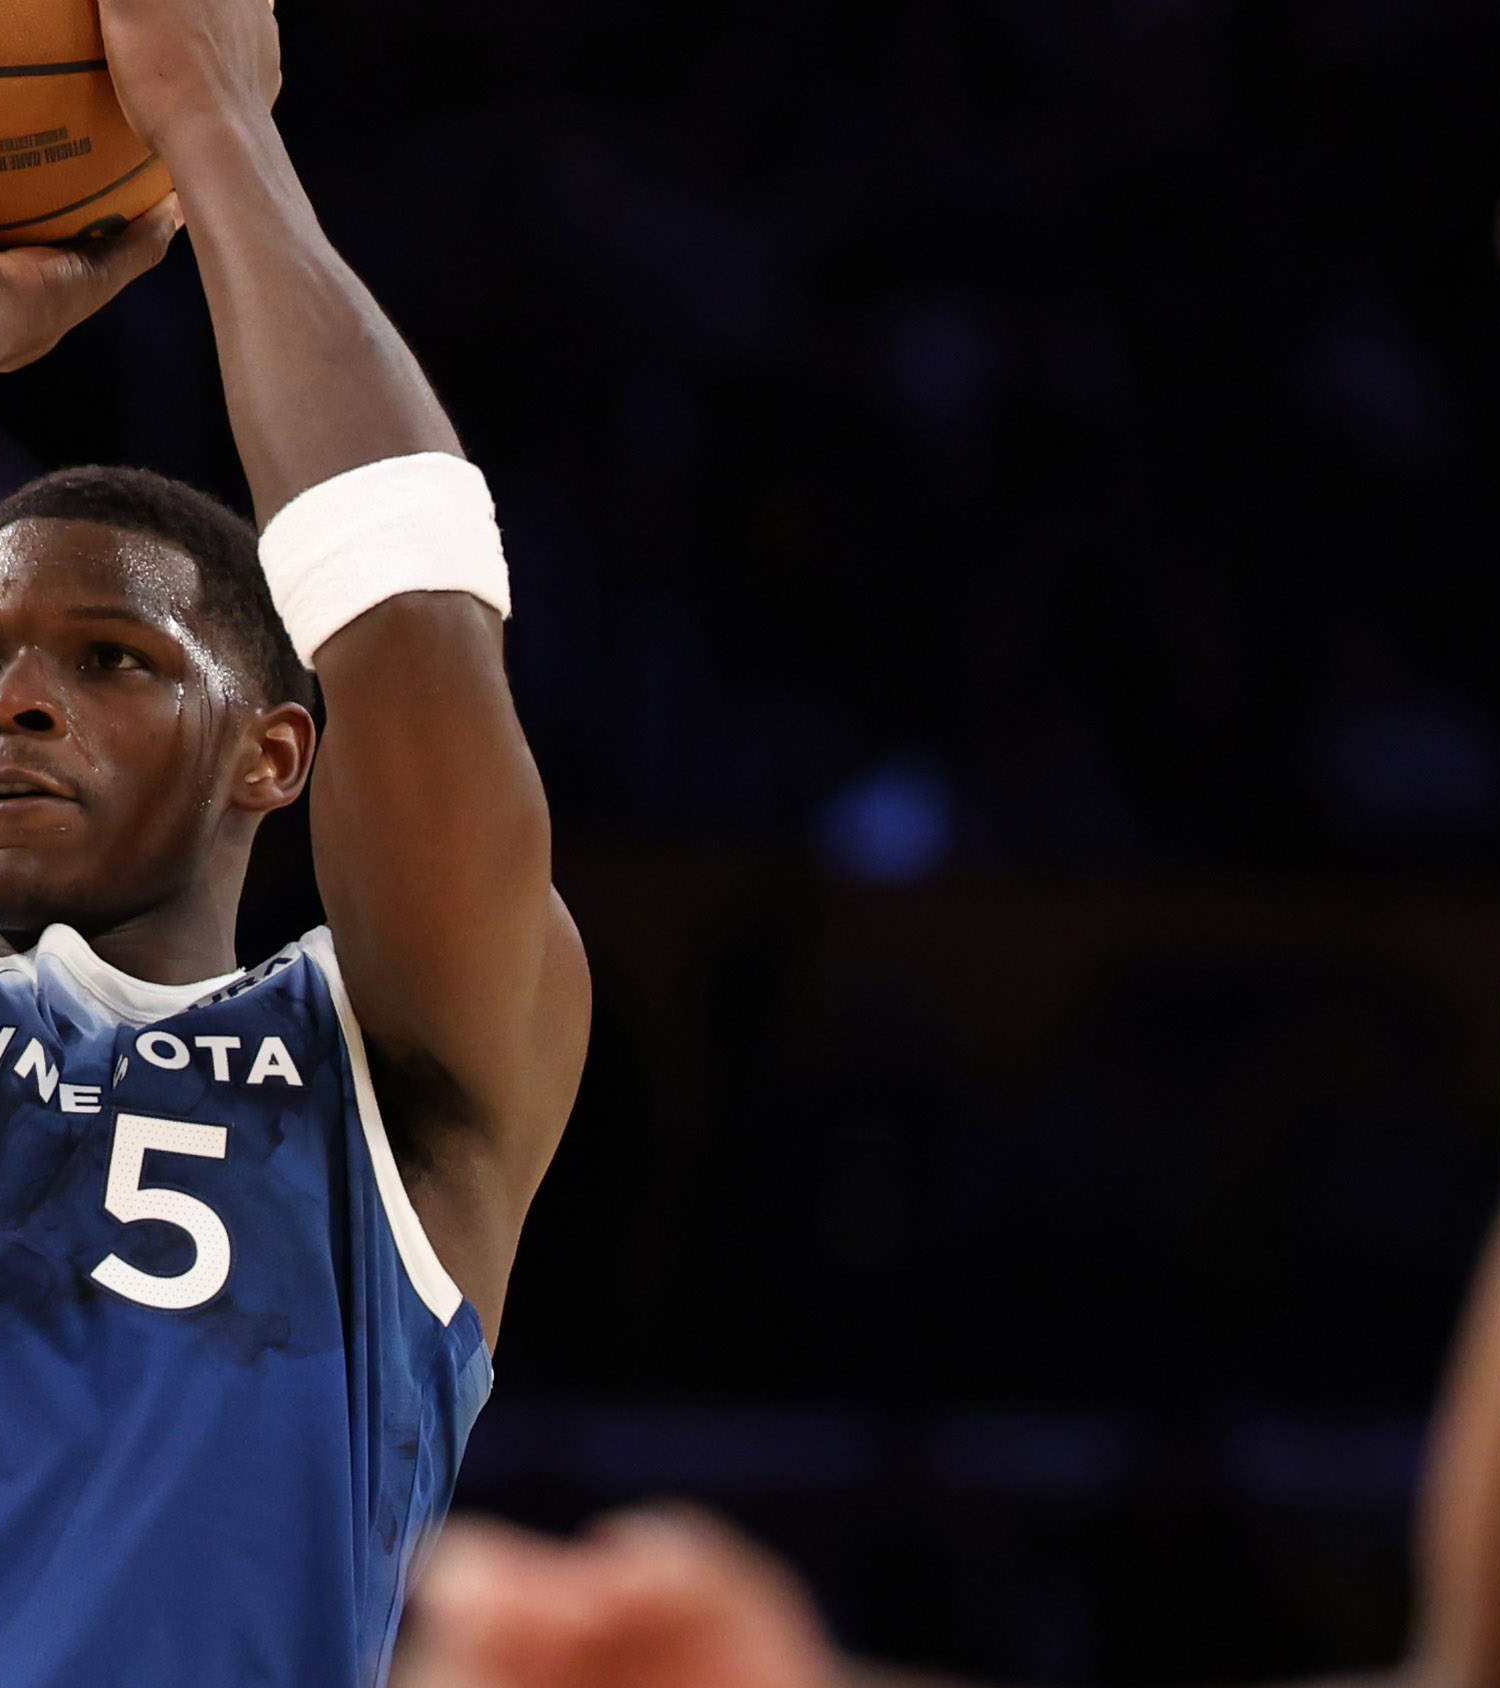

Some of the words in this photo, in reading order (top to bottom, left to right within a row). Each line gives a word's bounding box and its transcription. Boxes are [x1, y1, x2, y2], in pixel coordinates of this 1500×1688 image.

[10, 149, 43, 171] GAME
[44, 136, 92, 164] OFFICIAL
[90, 1112, 231, 1310] 5
